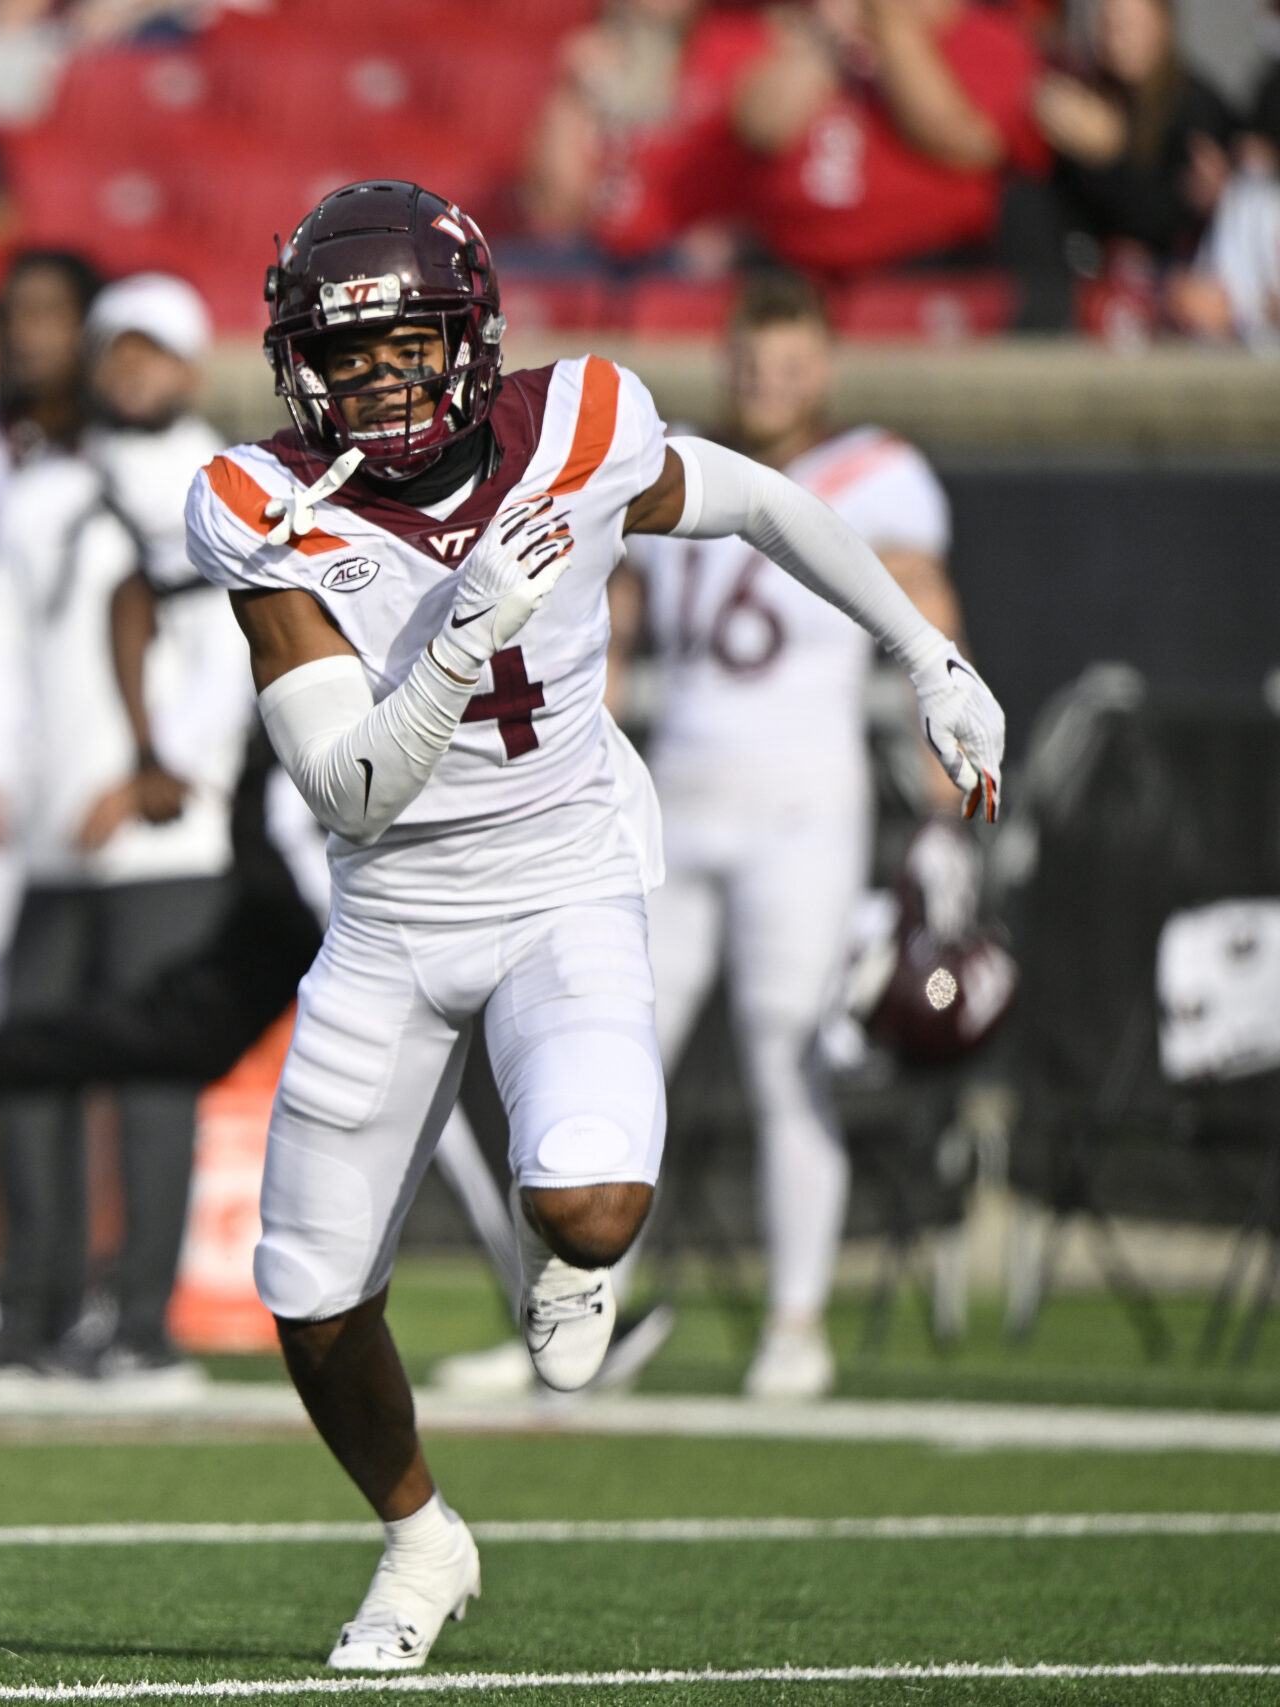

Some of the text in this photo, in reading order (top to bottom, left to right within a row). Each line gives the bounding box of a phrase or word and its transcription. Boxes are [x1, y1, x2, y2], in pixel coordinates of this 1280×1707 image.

[343, 281, 380, 304] VT
[426, 526, 478, 560] VT
[331, 560, 370, 585] ACC
[460, 645, 546, 761] 4
